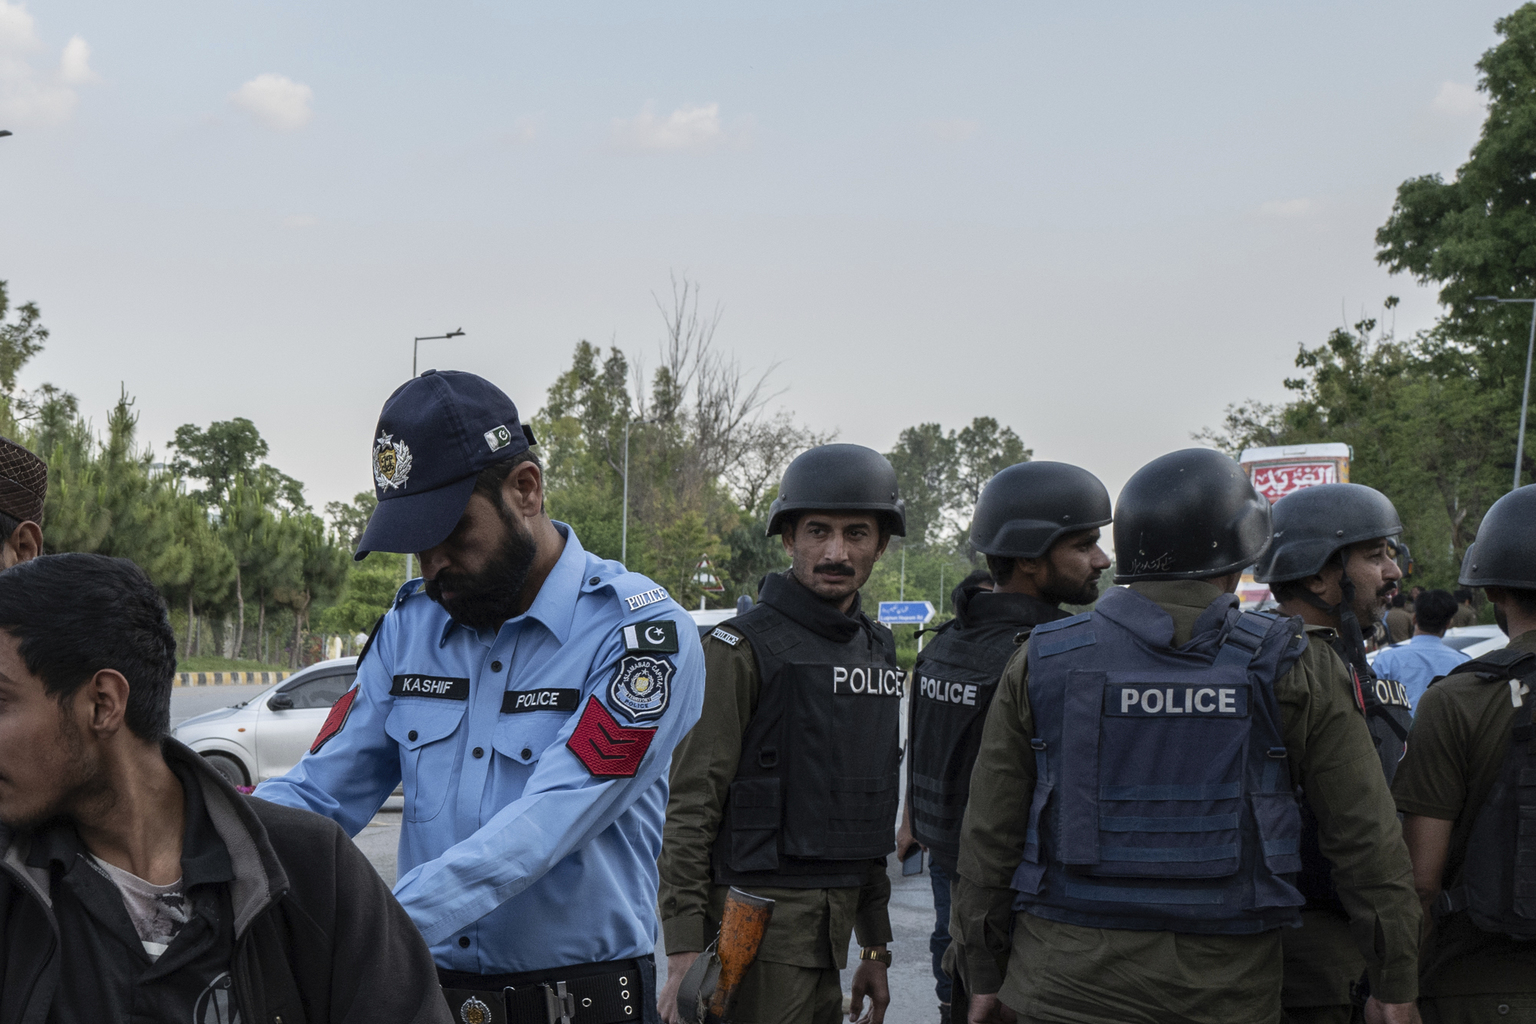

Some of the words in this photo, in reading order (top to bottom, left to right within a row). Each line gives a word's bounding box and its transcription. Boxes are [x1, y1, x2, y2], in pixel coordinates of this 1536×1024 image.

[625, 587, 668, 611] POLICE
[402, 677, 453, 694] KASHIF
[623, 661, 651, 682] ISLAMABAD
[651, 665, 664, 688] CAPITAL
[833, 666, 904, 697] POLICE
[515, 691, 559, 708] POLICE
[624, 698, 649, 709] POLICE
[920, 676, 977, 706] POLICE
[1120, 688, 1237, 713] POLICE
[1372, 680, 1412, 710] OLIC
